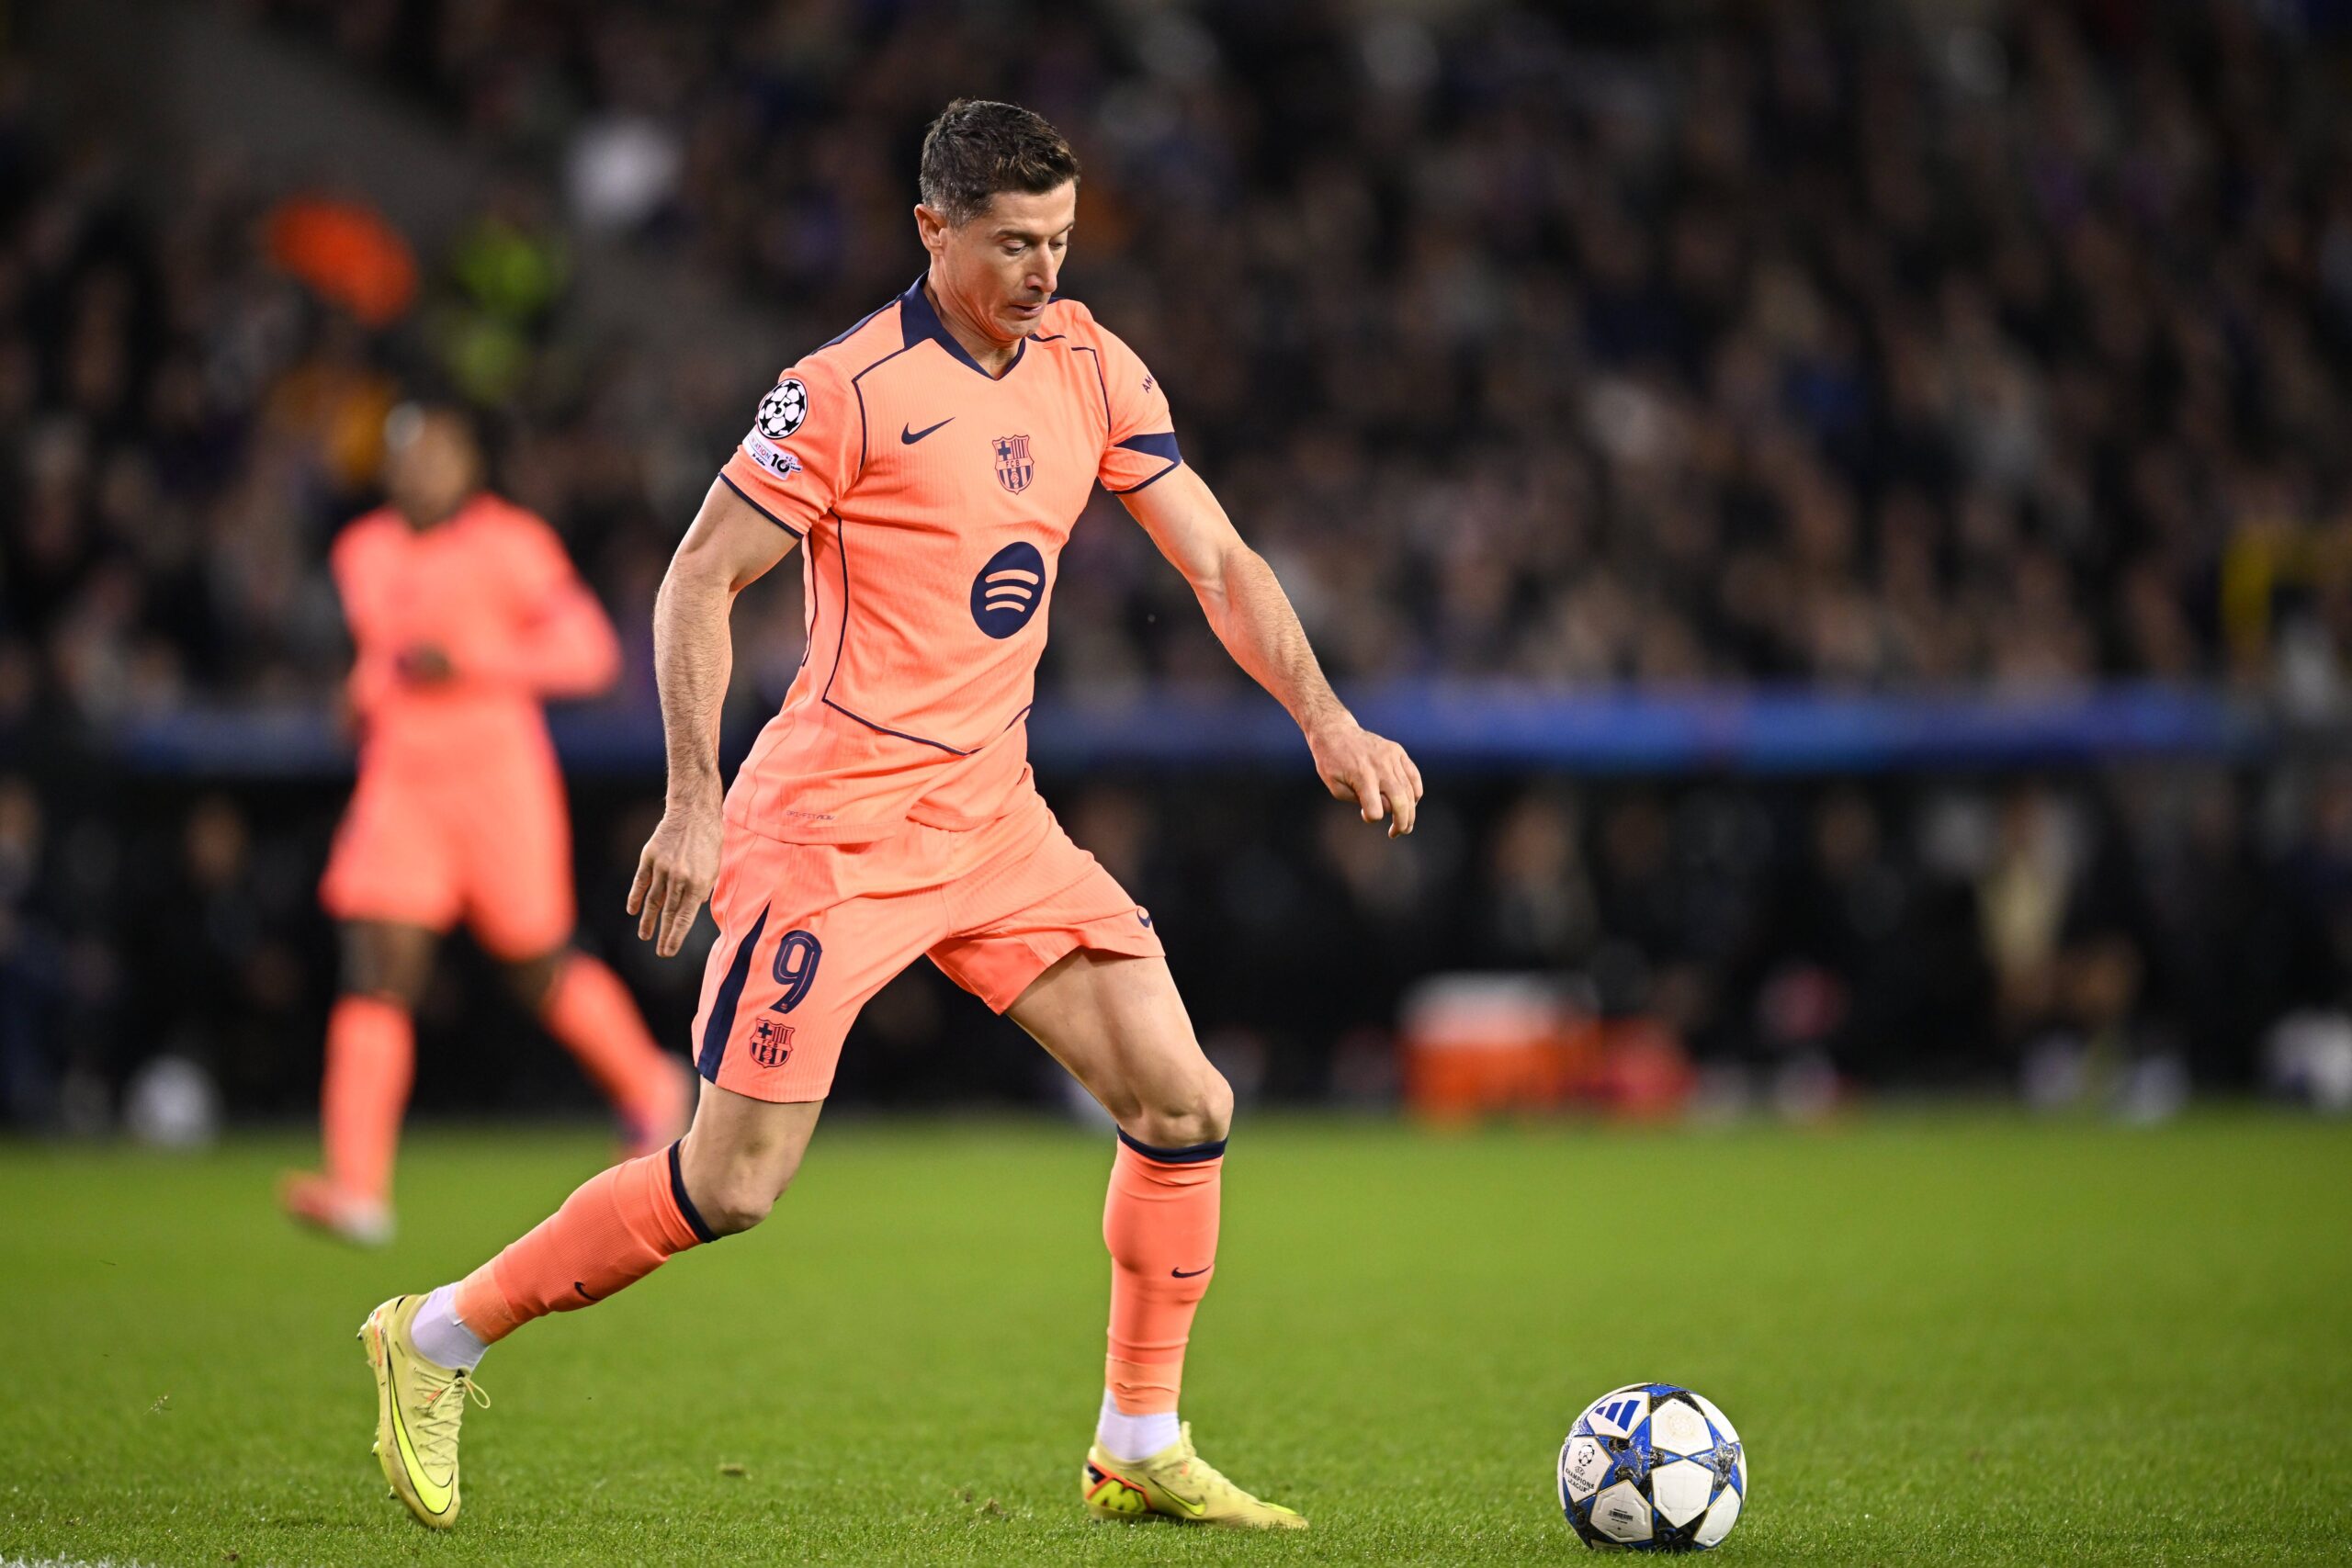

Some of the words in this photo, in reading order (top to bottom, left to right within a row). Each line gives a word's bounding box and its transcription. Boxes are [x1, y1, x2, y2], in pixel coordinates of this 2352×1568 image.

[773, 397, 792, 419] 5
[770, 453, 791, 473] 10
[1005, 459, 1021, 468] FCB
[768, 930, 823, 1015] 9
[762, 1039, 778, 1048] FCB
[1566, 1468, 1595, 1490] CHAMPIONS
[1567, 1479, 1588, 1494] LEAGUE
